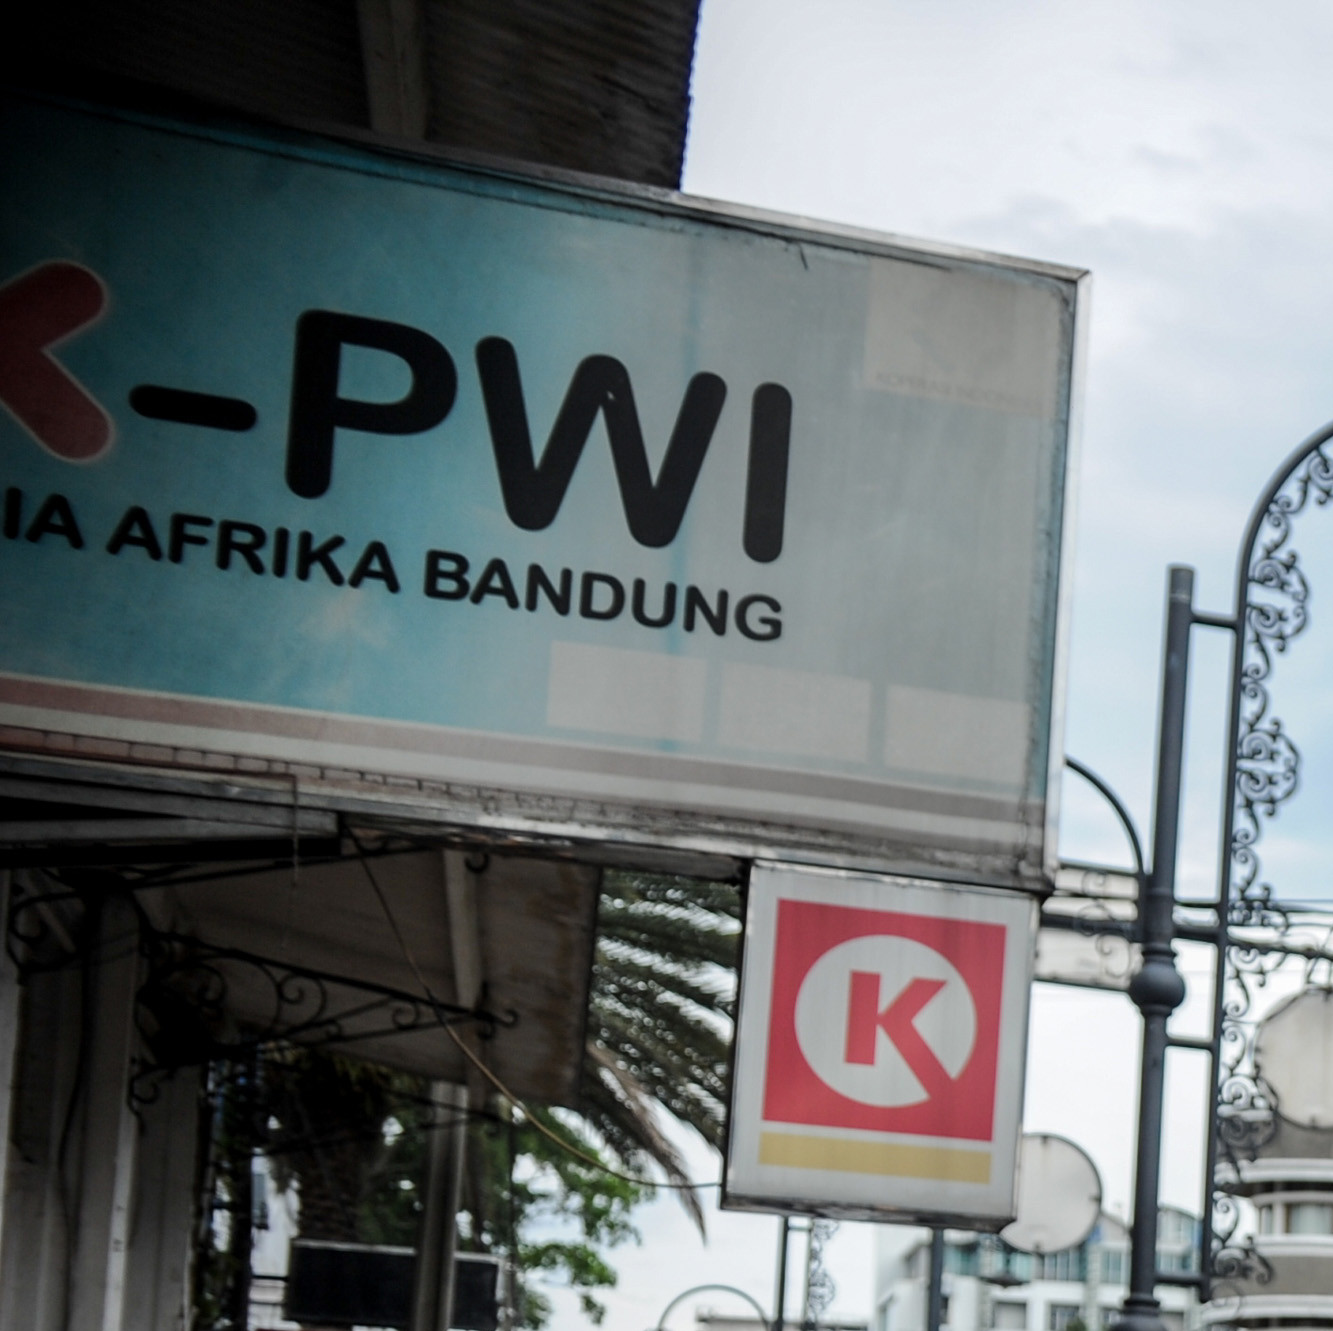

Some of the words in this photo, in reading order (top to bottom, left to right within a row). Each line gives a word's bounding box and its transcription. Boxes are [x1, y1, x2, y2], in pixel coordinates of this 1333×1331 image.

[106, 505, 400, 594] AFRIKA
[424, 548, 783, 642] BANDUNG
[844, 970, 959, 1101] K
